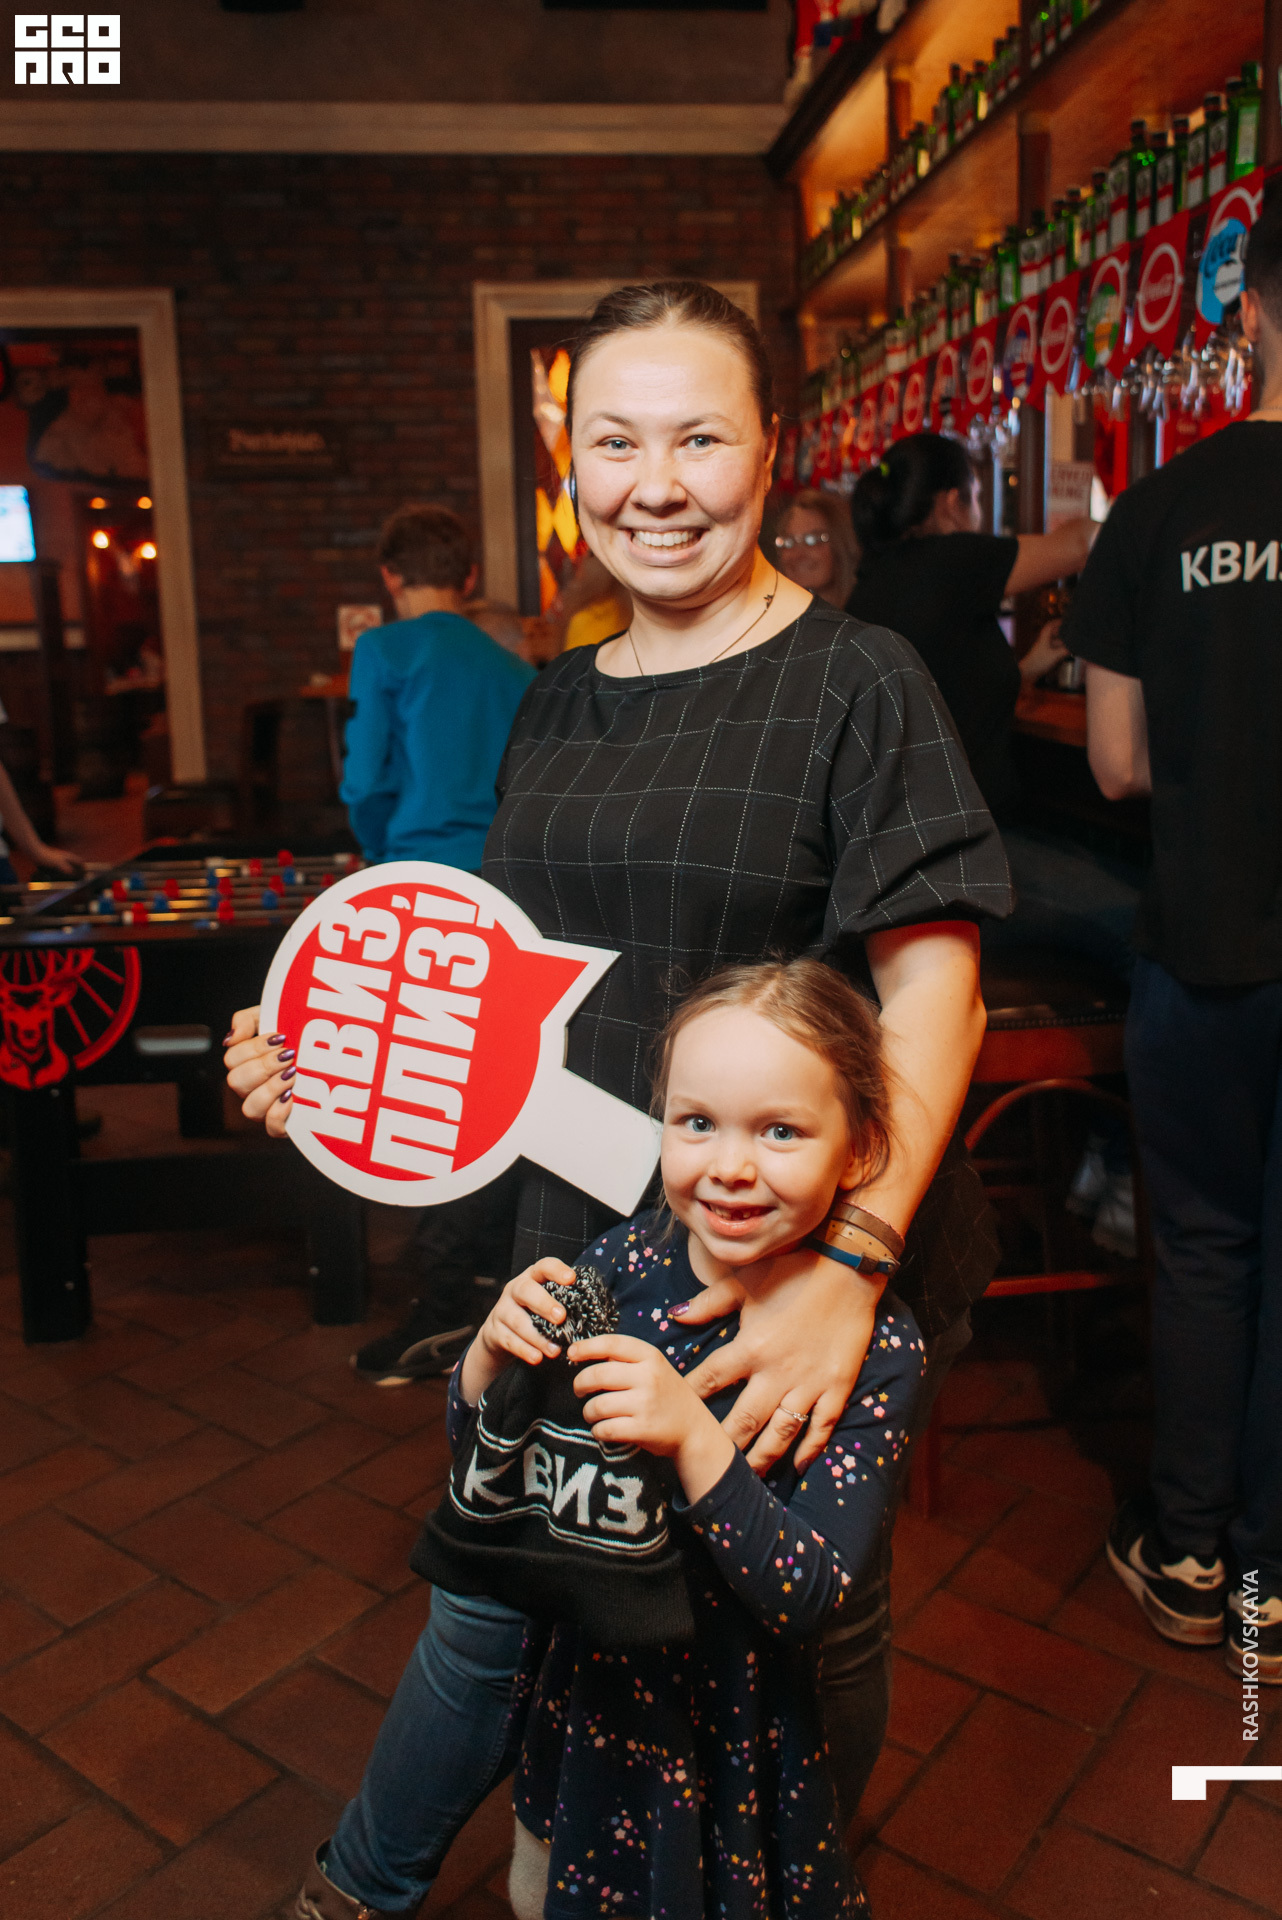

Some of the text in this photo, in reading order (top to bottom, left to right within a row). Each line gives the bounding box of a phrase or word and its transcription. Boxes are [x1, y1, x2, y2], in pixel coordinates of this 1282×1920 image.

[1180, 540, 1282, 593] КВИ
[290, 894, 411, 1145] КВИЗ,
[369, 891, 495, 1178] ПЛИЗ!
